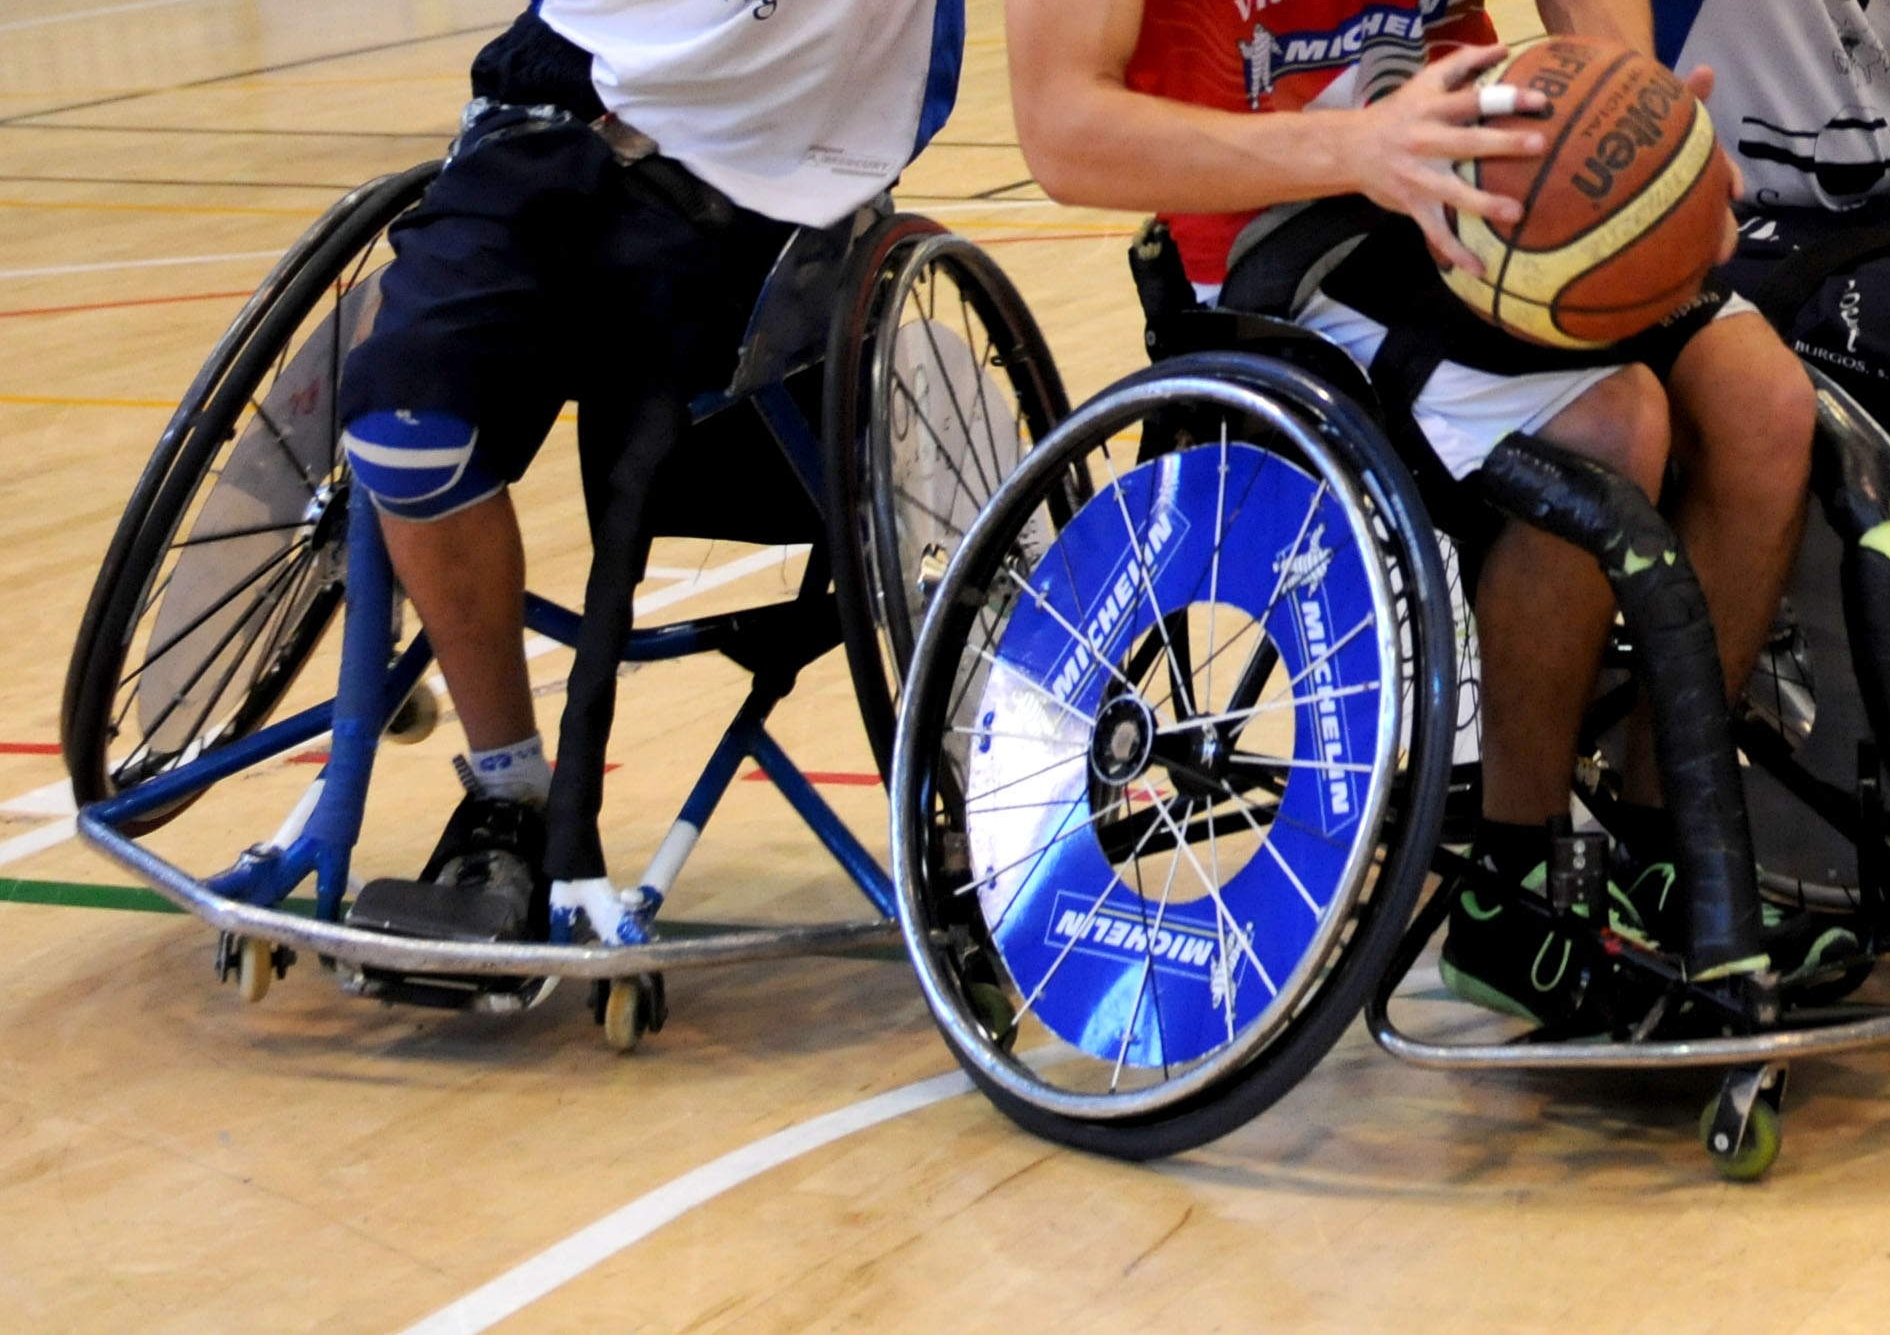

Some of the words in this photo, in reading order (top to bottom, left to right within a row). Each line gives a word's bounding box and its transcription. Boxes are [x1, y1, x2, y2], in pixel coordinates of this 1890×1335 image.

[1570, 64, 1686, 200] molten
[1301, 600, 1350, 815] MICHELIN
[1054, 908, 1216, 967] MICHELIN
